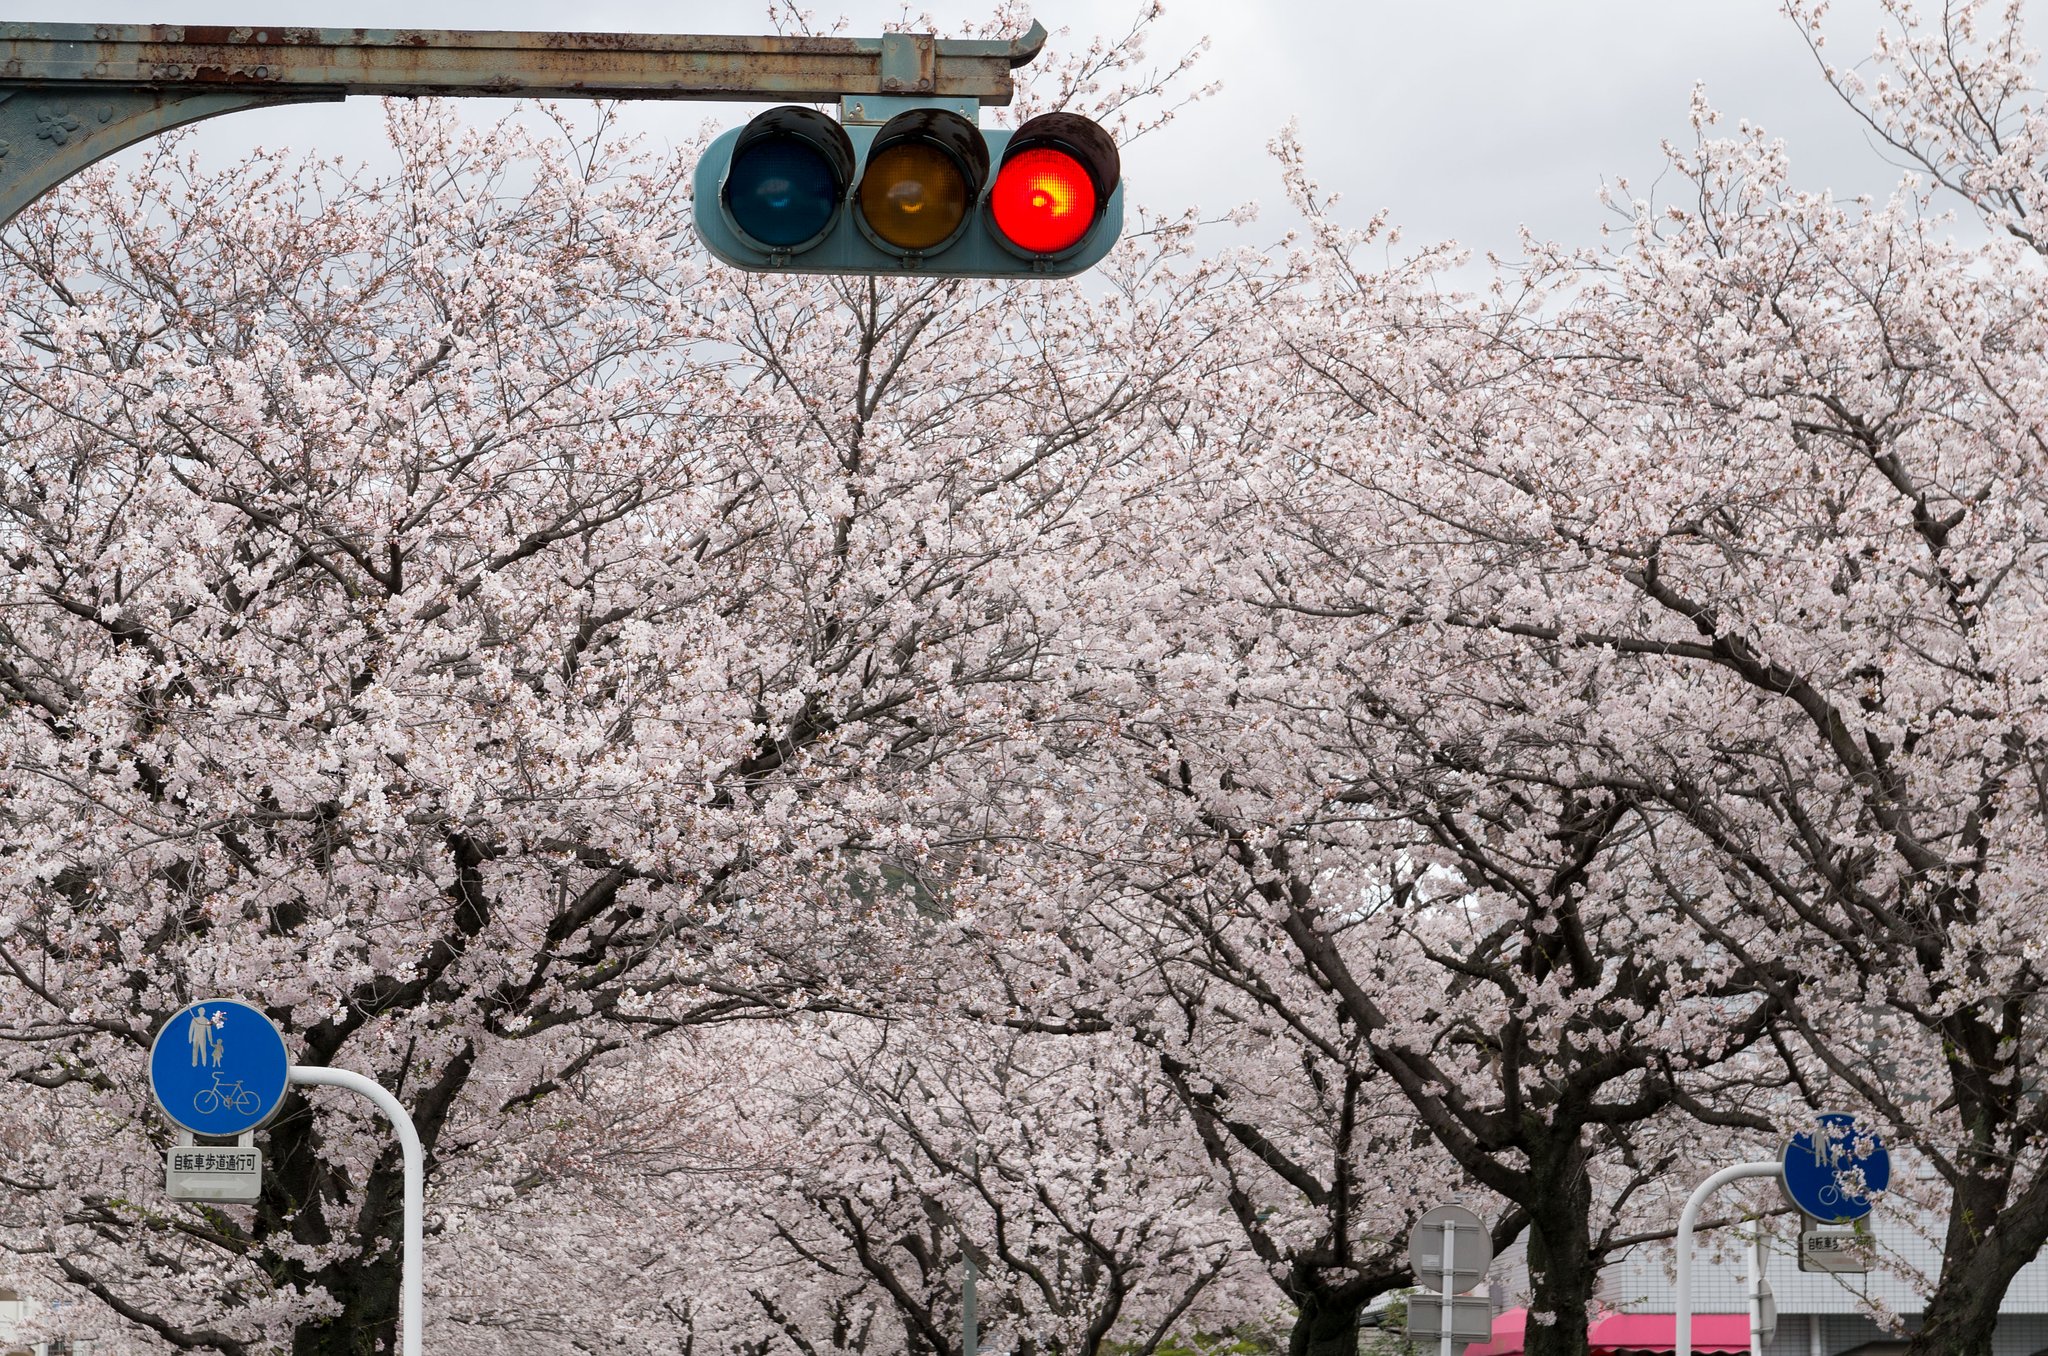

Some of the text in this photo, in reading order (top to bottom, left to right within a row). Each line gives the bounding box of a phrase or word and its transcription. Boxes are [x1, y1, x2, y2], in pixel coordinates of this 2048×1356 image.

[174, 1153, 256, 1171] 自転車歩道通行可
